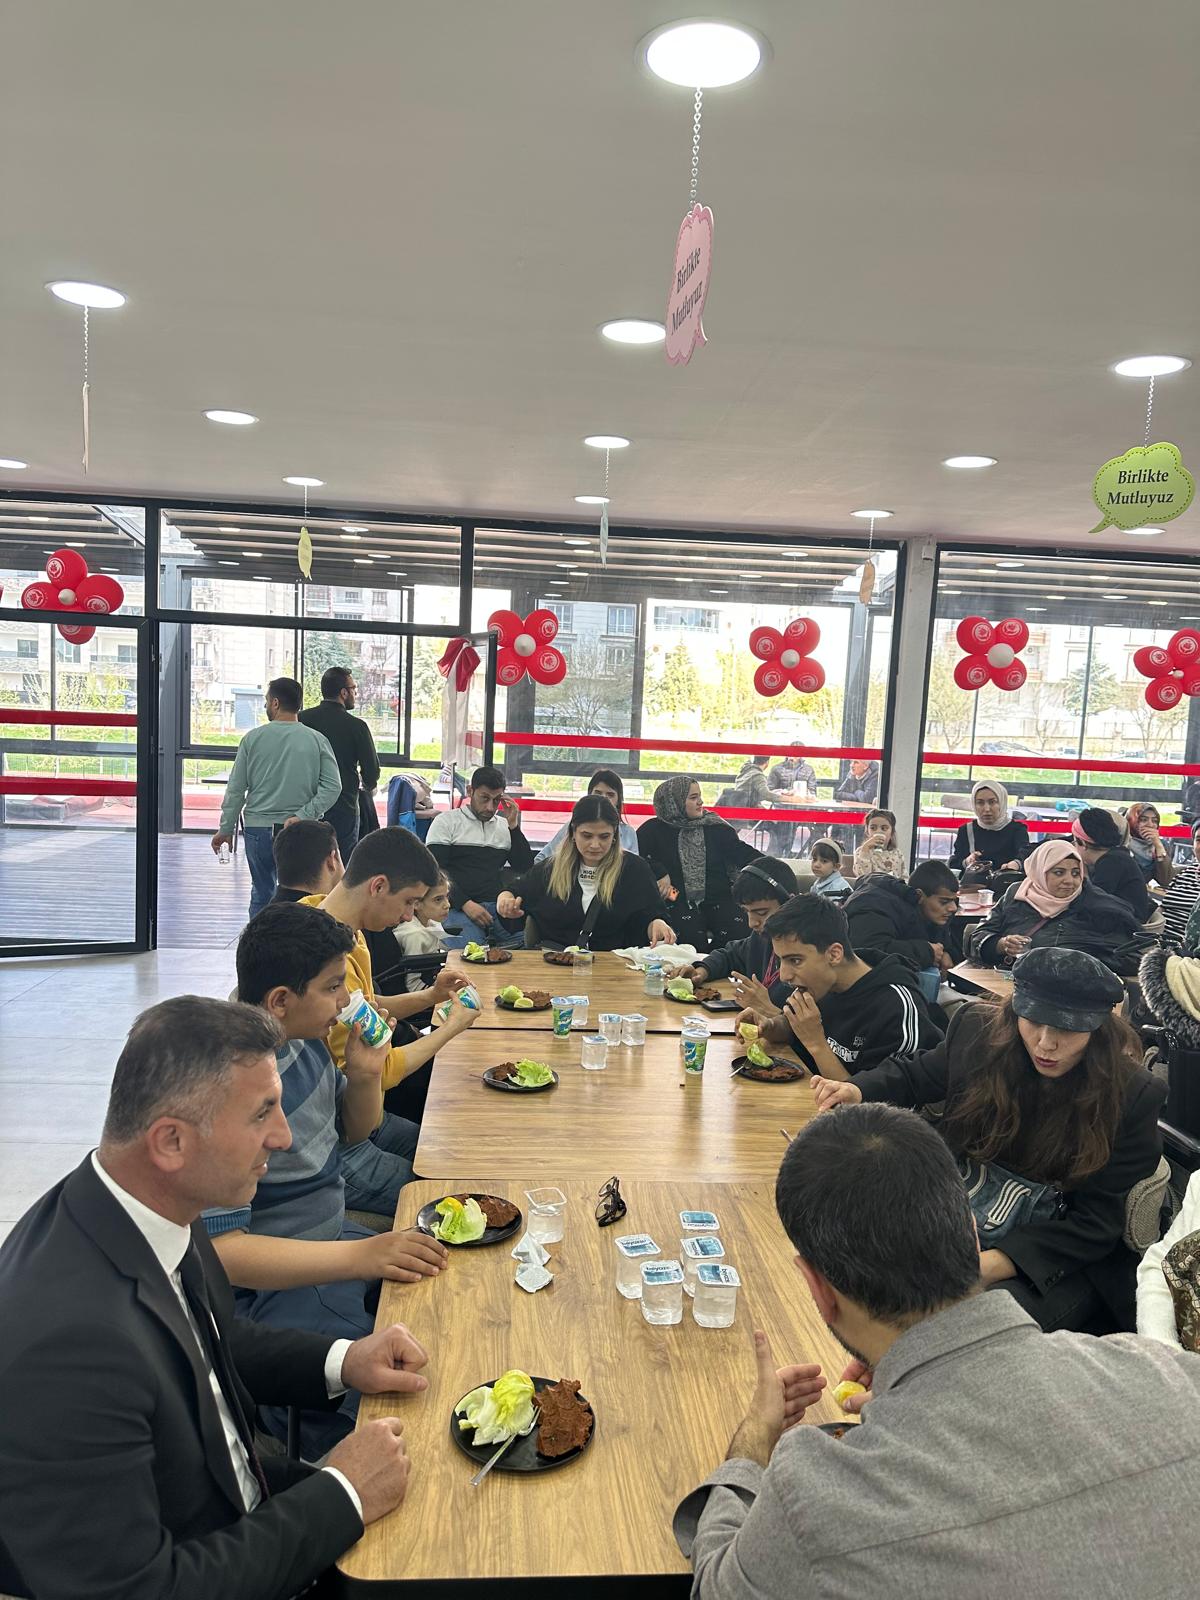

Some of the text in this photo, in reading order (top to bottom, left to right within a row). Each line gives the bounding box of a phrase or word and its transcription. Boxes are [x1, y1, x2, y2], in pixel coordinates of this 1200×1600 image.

[676, 247, 701, 294] Birlikte
[671, 281, 703, 335] Mutluyuz
[1118, 469, 1169, 485] Birlikte
[1107, 491, 1174, 508] Mutluyuz
